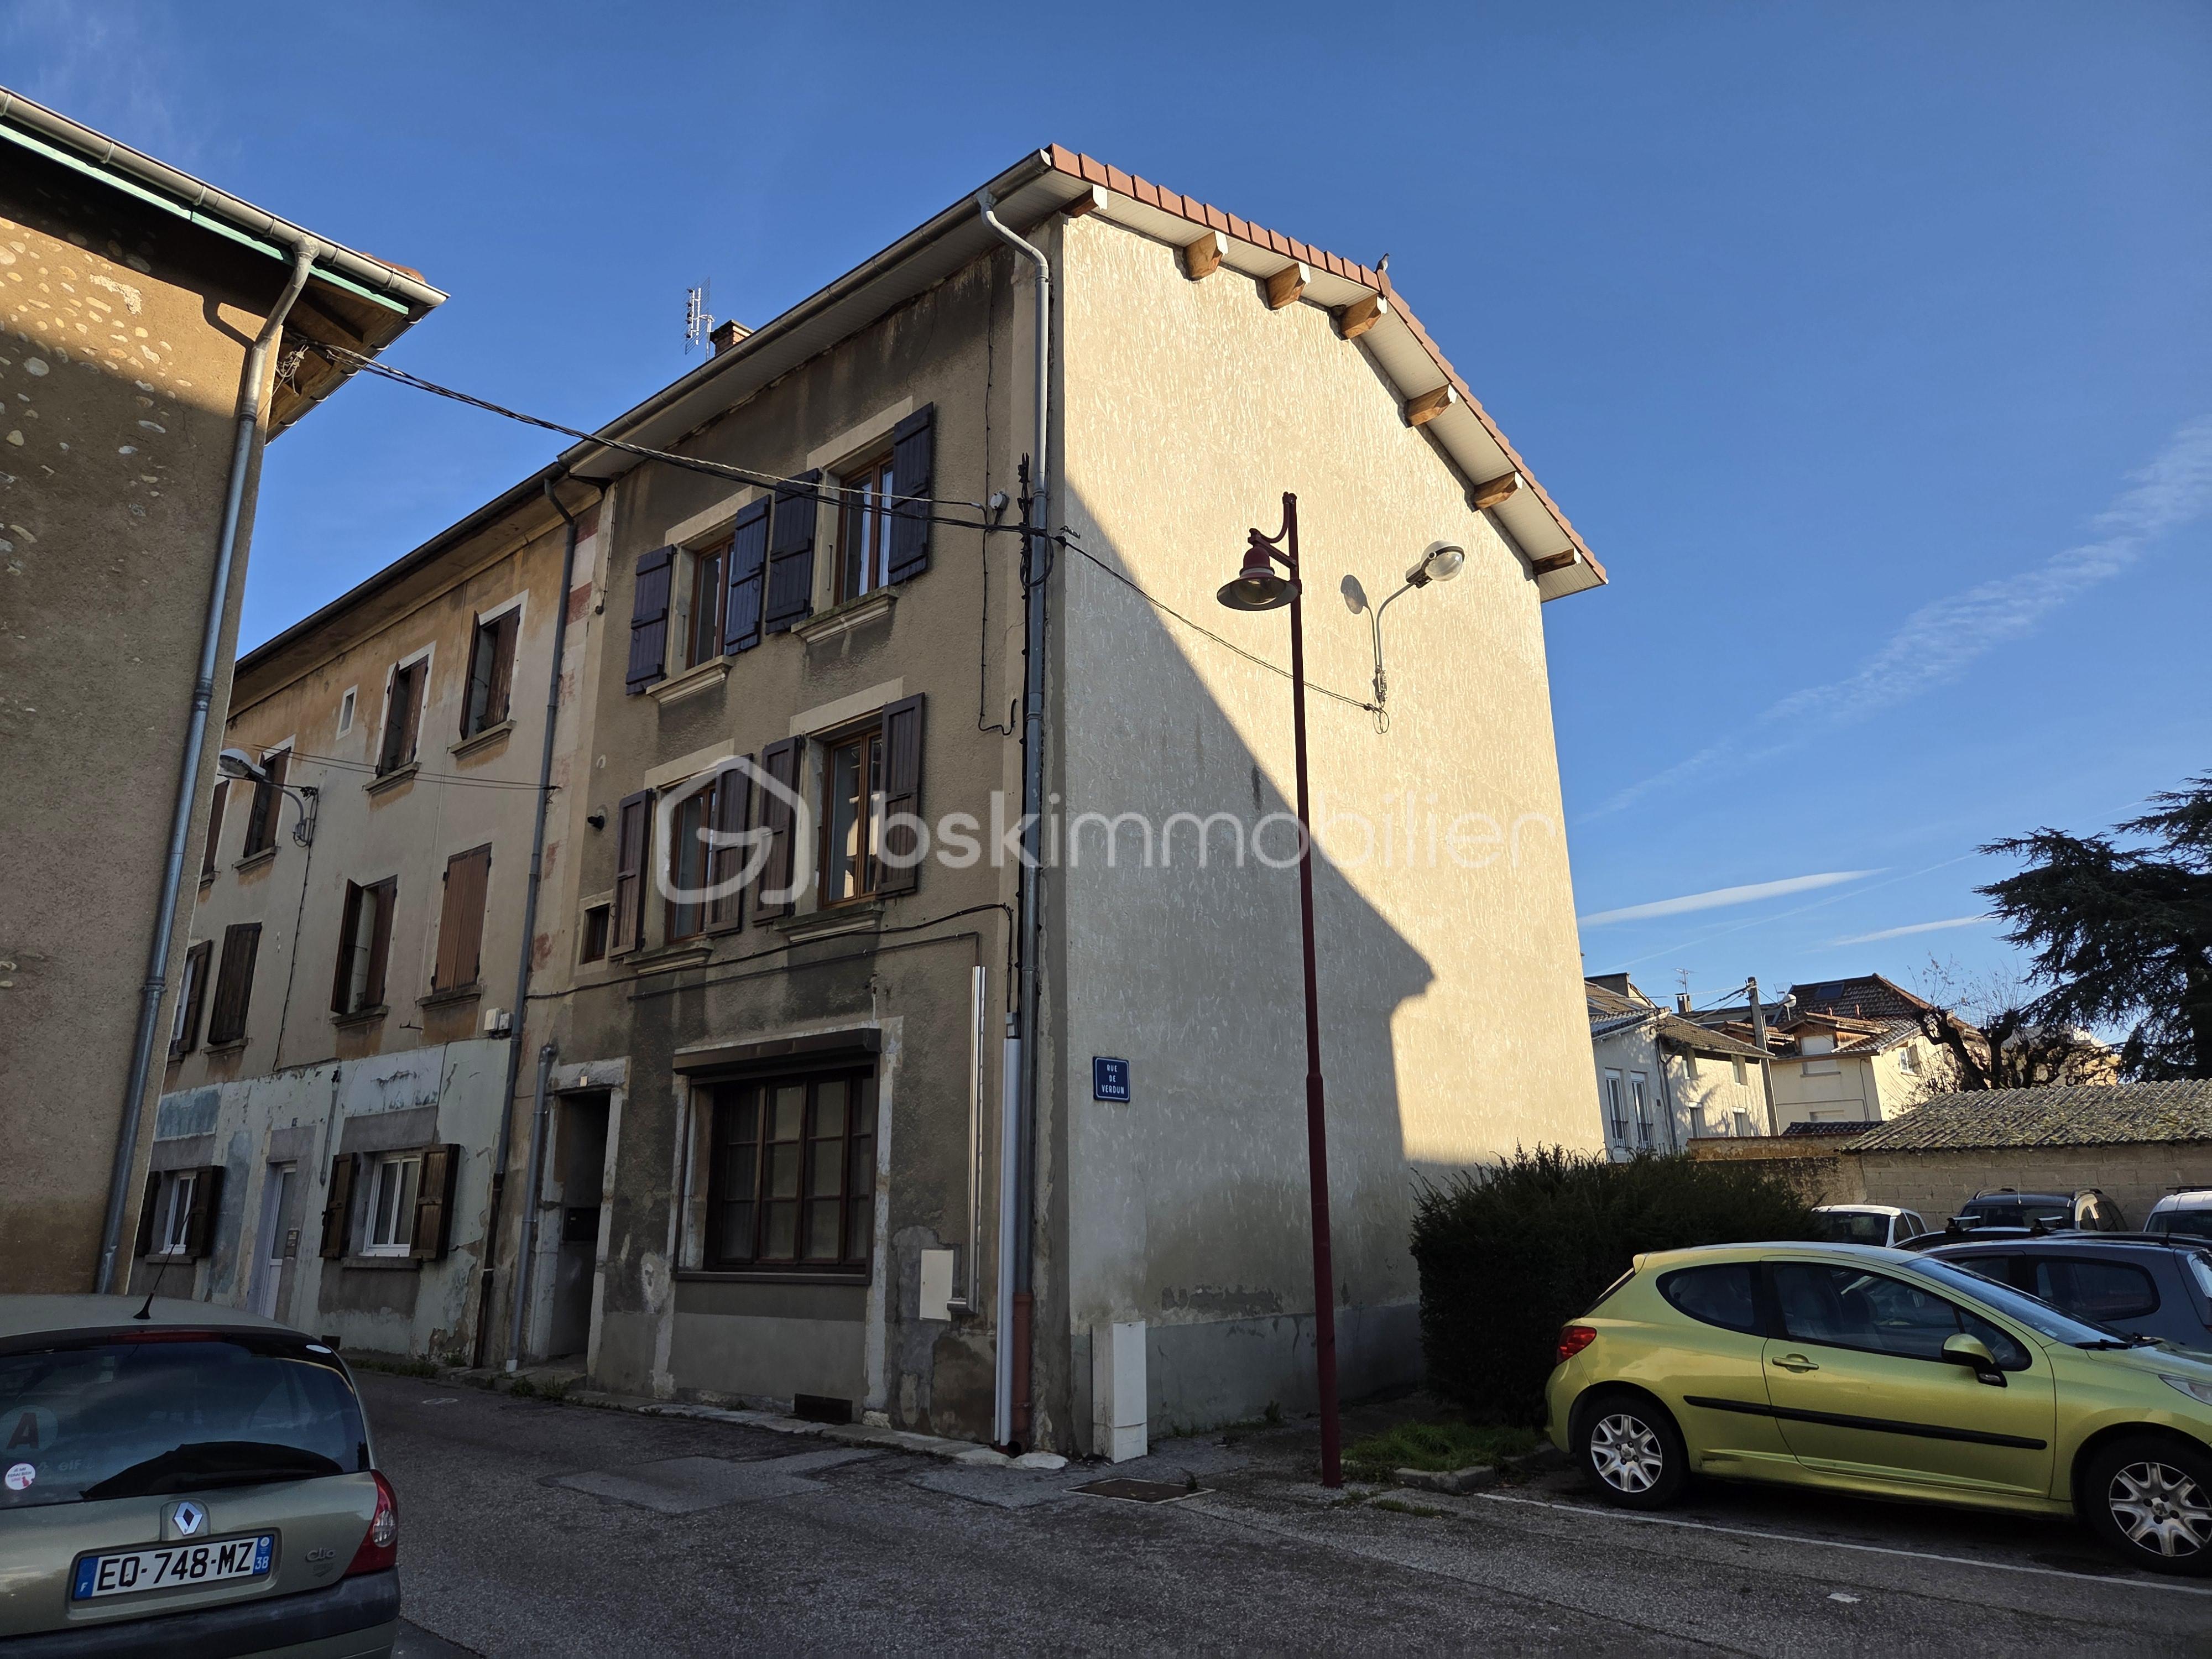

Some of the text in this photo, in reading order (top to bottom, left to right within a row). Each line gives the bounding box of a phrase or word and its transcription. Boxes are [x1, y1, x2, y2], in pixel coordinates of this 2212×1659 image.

[1107, 1064, 1117, 1072] RUE
[1102, 1084, 1124, 1094] VERDUN
[7, 1412, 39, 1449] A
[97, 1542, 254, 1591] EQ-748-MZ
[255, 1556, 269, 1569] 38
[80, 1582, 88, 1592] F
